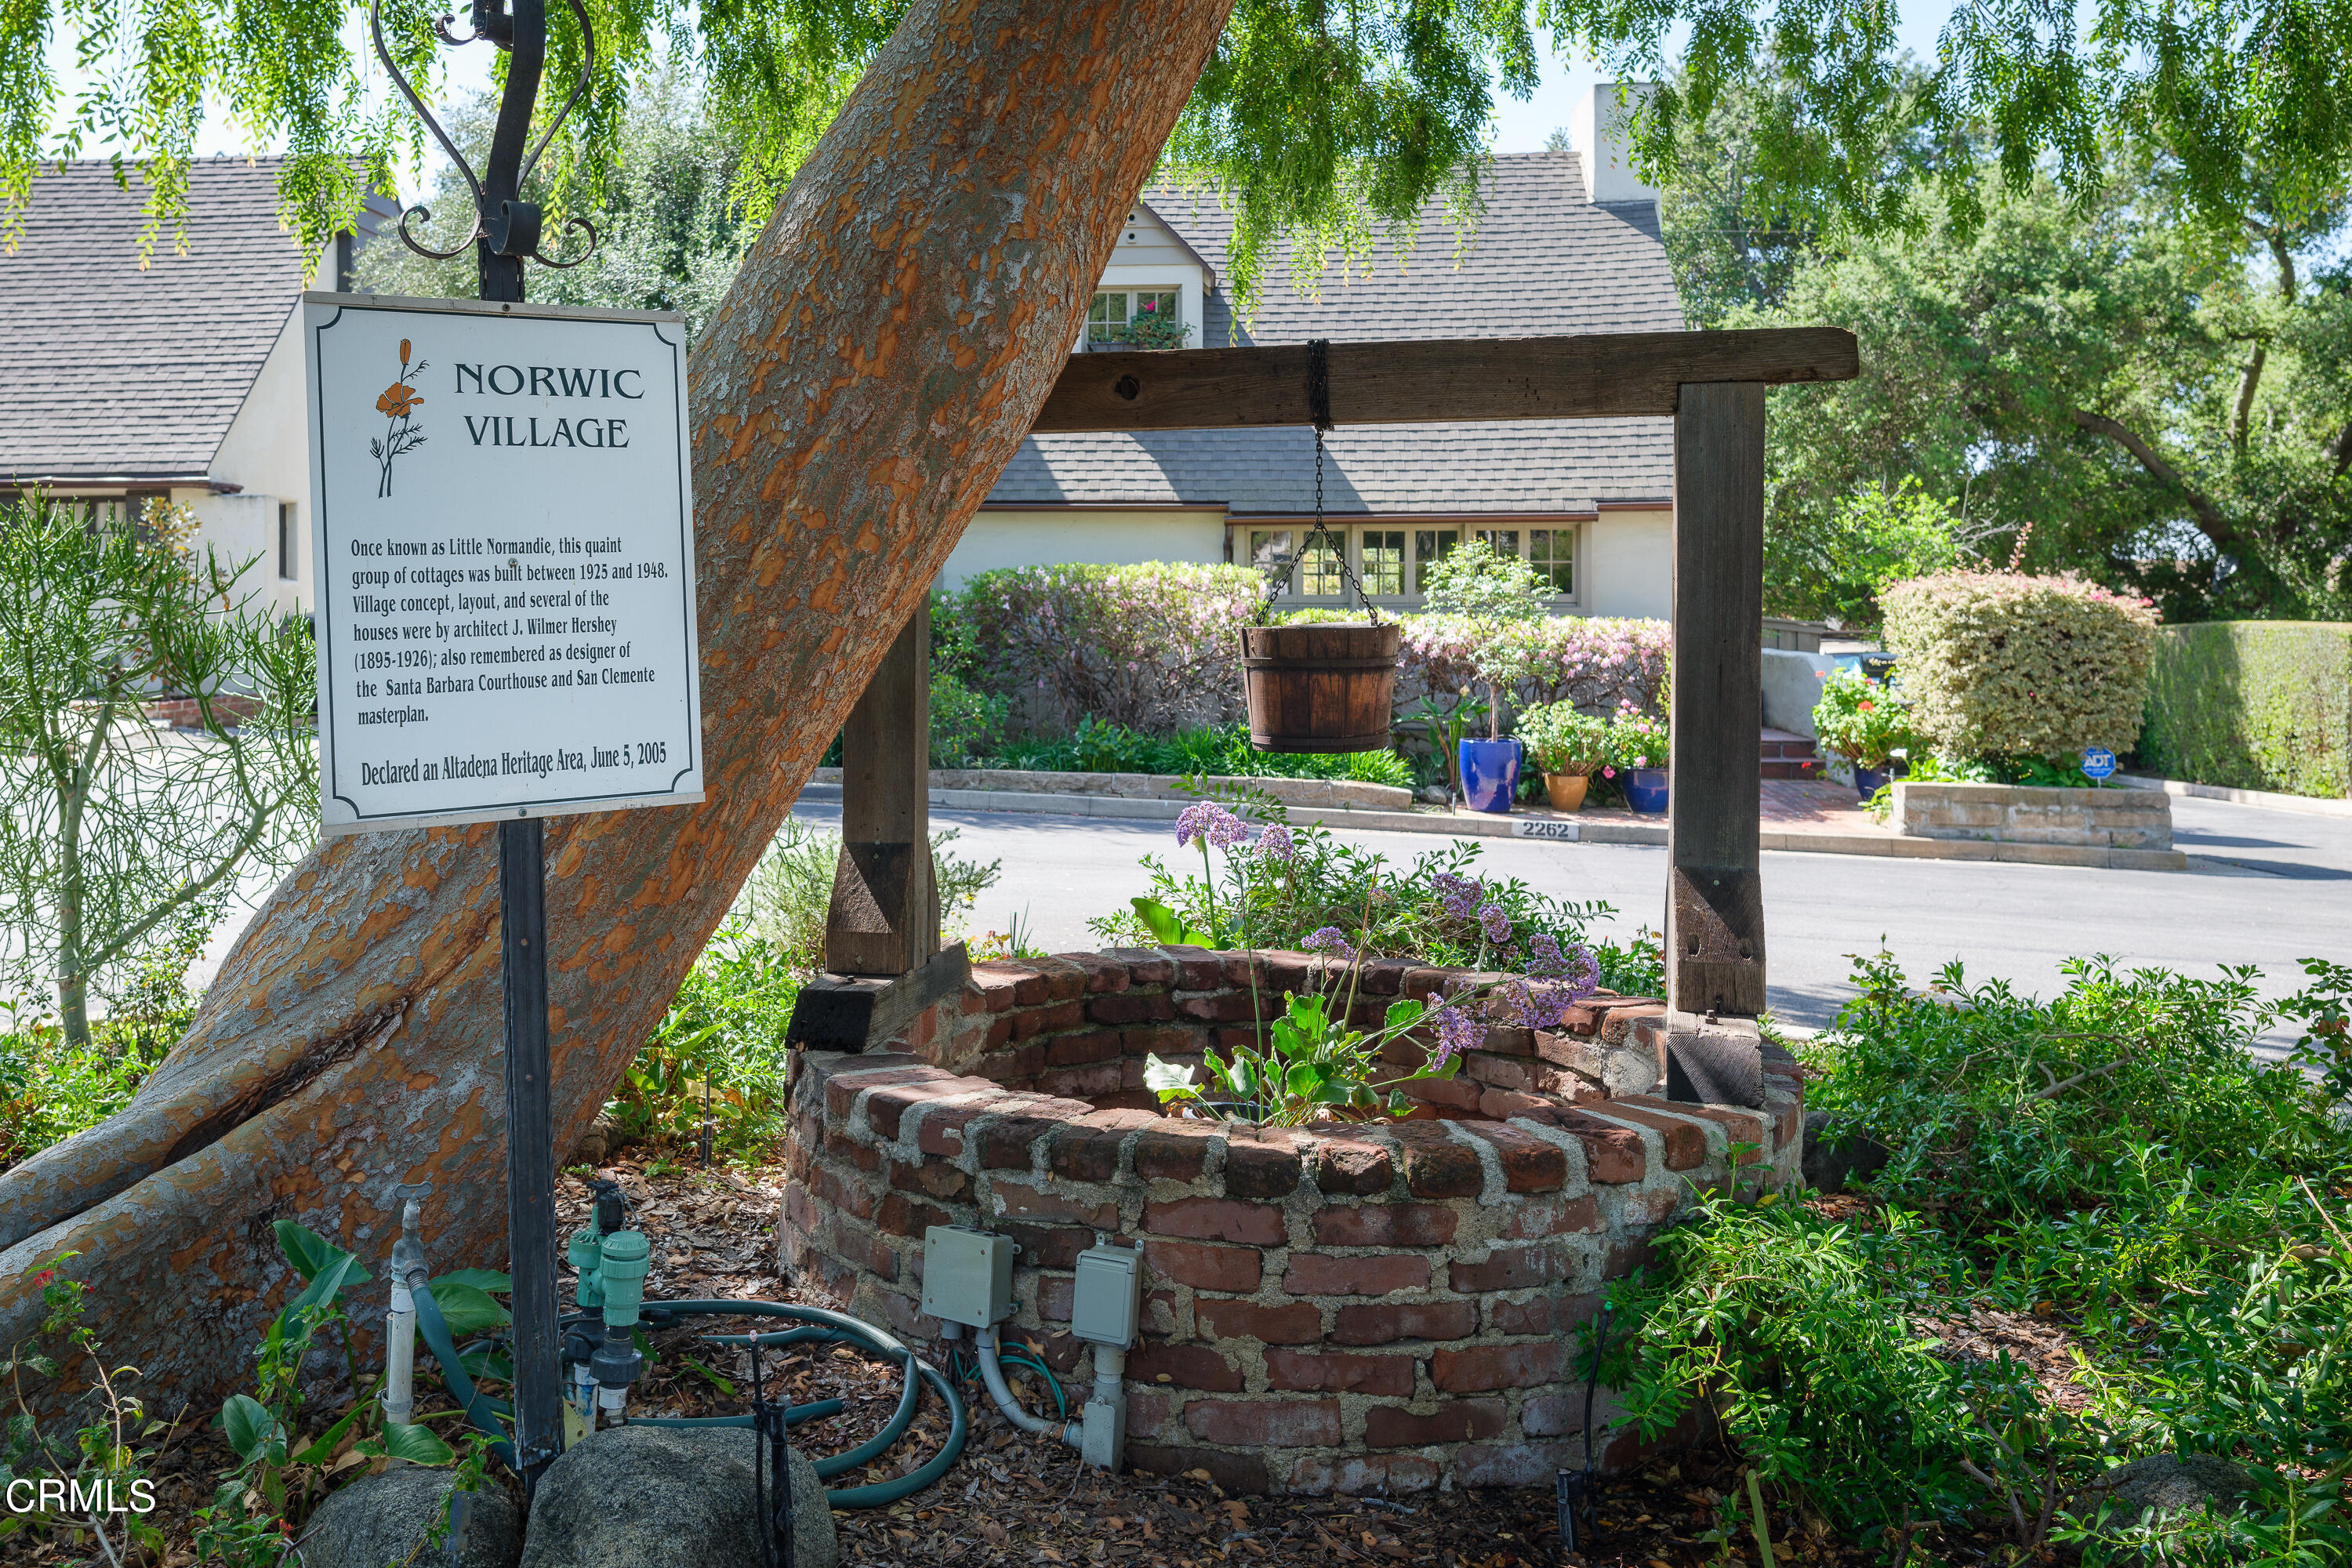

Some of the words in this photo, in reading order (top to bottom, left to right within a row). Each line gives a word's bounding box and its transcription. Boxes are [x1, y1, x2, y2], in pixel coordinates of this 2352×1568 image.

[453, 363, 645, 399] NORWIC
[463, 416, 630, 448] VILLAGE
[350, 539, 383, 557] Once
[387, 538, 427, 556] known
[431, 542, 445, 556] as
[449, 538, 483, 555] Little
[486, 536, 555, 557] Normandie,
[559, 536, 581, 554] this
[585, 536, 622, 557] quaint
[352, 571, 390, 590] group
[394, 566, 408, 584] of
[411, 566, 464, 588] cottages
[468, 569, 490, 583] was
[494, 563, 522, 583] built
[526, 564, 575, 581] between
[580, 563, 608, 580] 1925
[612, 562, 633, 579] and
[637, 561, 668, 579] 1948.
[352, 595, 396, 617] Village
[401, 593, 455, 615] concept,
[458, 593, 500, 615] layout,
[503, 591, 526, 609] and
[530, 590, 572, 608] several
[575, 590, 587, 607] of
[590, 590, 609, 606] the
[354, 623, 398, 641] houses
[402, 626, 431, 640] were
[436, 621, 450, 643] by
[453, 619, 508, 638] architect
[512, 619, 523, 636] J.
[527, 617, 568, 635] Wilmer
[572, 615, 616, 637] Hershey
[354, 649, 437, 673] (1895-1926);
[441, 648, 466, 666] also
[470, 644, 545, 665] remembered
[549, 648, 562, 661] as
[565, 642, 616, 664] designer
[619, 641, 631, 658] of
[356, 680, 377, 698] the
[386, 678, 422, 696] Santa
[426, 675, 474, 694] Barbara
[478, 672, 547, 691] Courthouse
[551, 670, 573, 688] and
[577, 670, 597, 686] San
[601, 666, 655, 684] Clemente
[358, 705, 429, 728] masterplan.
[361, 757, 419, 786] Declared
[423, 763, 439, 782] an
[441, 753, 498, 780] Altadena
[501, 750, 554, 779] Heritage
[556, 748, 586, 772] Area,
[590, 746, 619, 768] June
[622, 744, 634, 769] 5,
[637, 741, 666, 765] 2005
[2083, 754, 2111, 768] ADT
[1523, 822, 1569, 837] 2262
